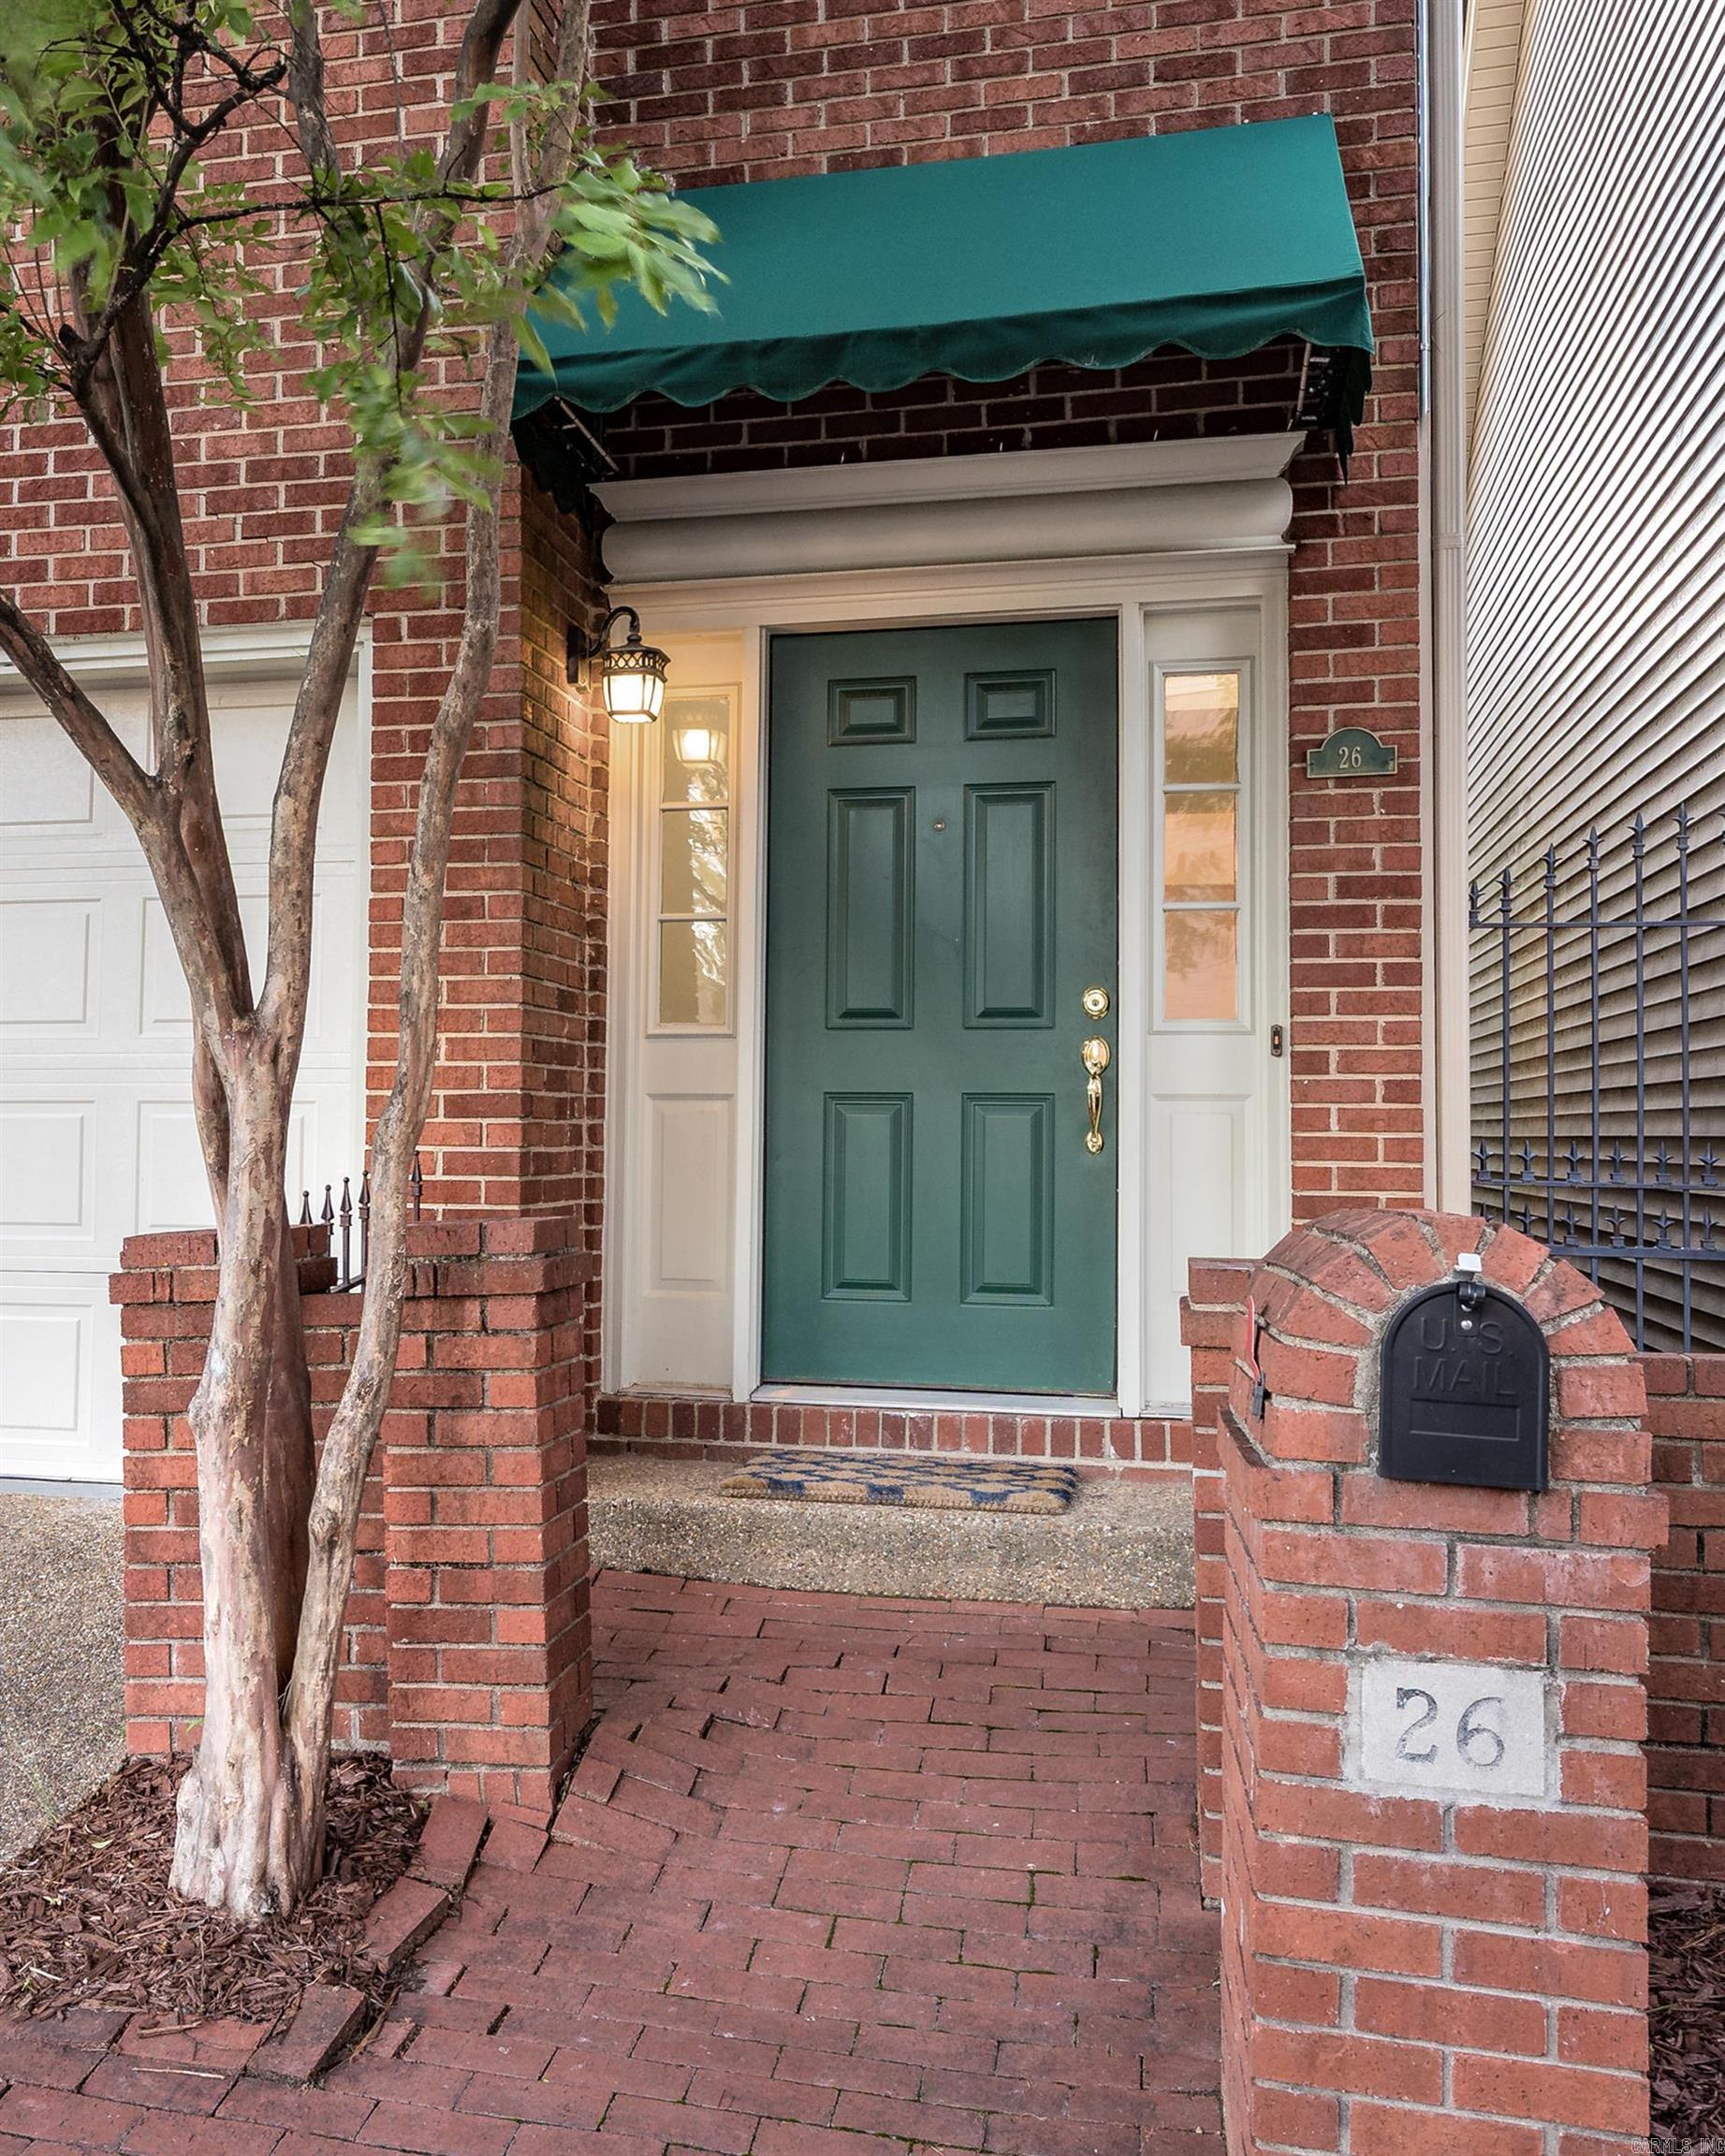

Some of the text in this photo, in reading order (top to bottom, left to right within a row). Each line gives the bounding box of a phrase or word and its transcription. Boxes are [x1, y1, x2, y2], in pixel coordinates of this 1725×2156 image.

[1338, 746, 1362, 769] 26
[1420, 1317, 1513, 1358] U.S.
[1412, 1356, 1515, 1399] MAIL
[1396, 1687, 1505, 1769] 26
